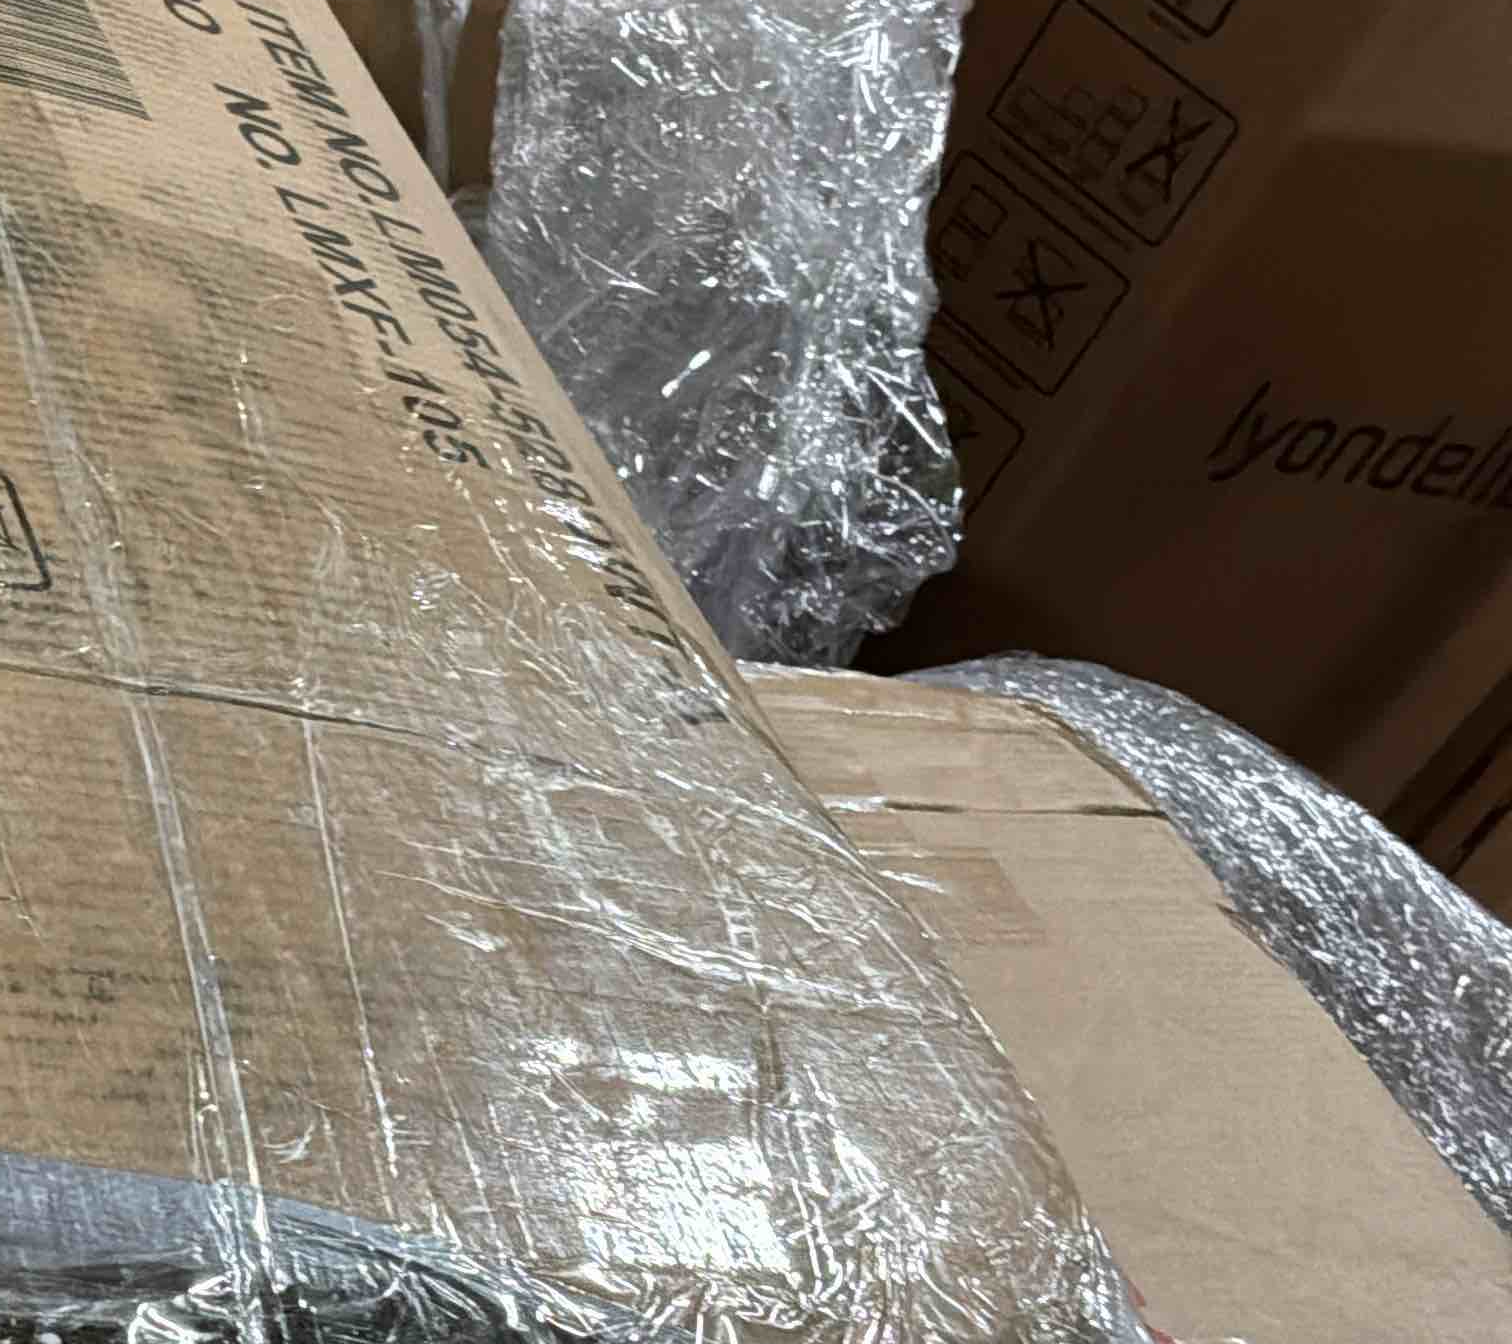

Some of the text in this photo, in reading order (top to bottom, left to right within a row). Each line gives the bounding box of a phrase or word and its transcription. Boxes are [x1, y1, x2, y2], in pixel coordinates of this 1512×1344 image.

[235, 0, 350, 117] ITEM
[312, 119, 400, 204] NO.
[213, 83, 301, 169] NO.
[273, 184, 489, 469] LMXF-105
